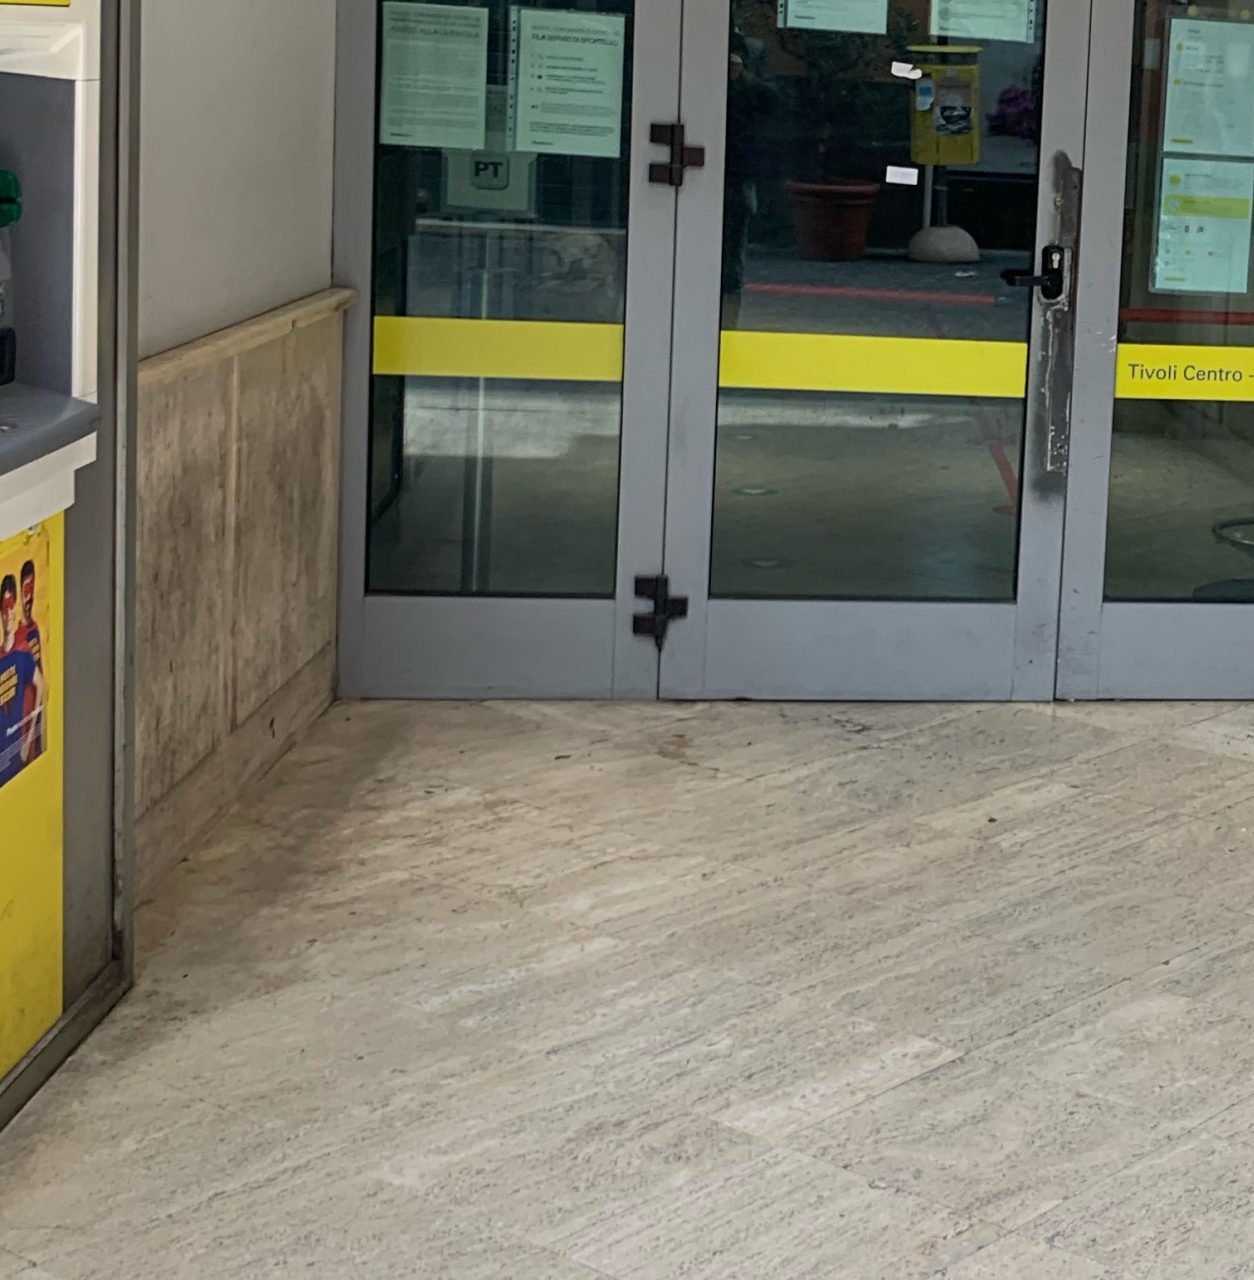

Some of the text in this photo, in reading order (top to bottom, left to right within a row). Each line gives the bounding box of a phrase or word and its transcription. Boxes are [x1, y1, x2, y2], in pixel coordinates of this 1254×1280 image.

[474, 160, 503, 179] PT
[1128, 364, 1177, 381] Tivoli
[1184, 365, 1243, 382] Centro
